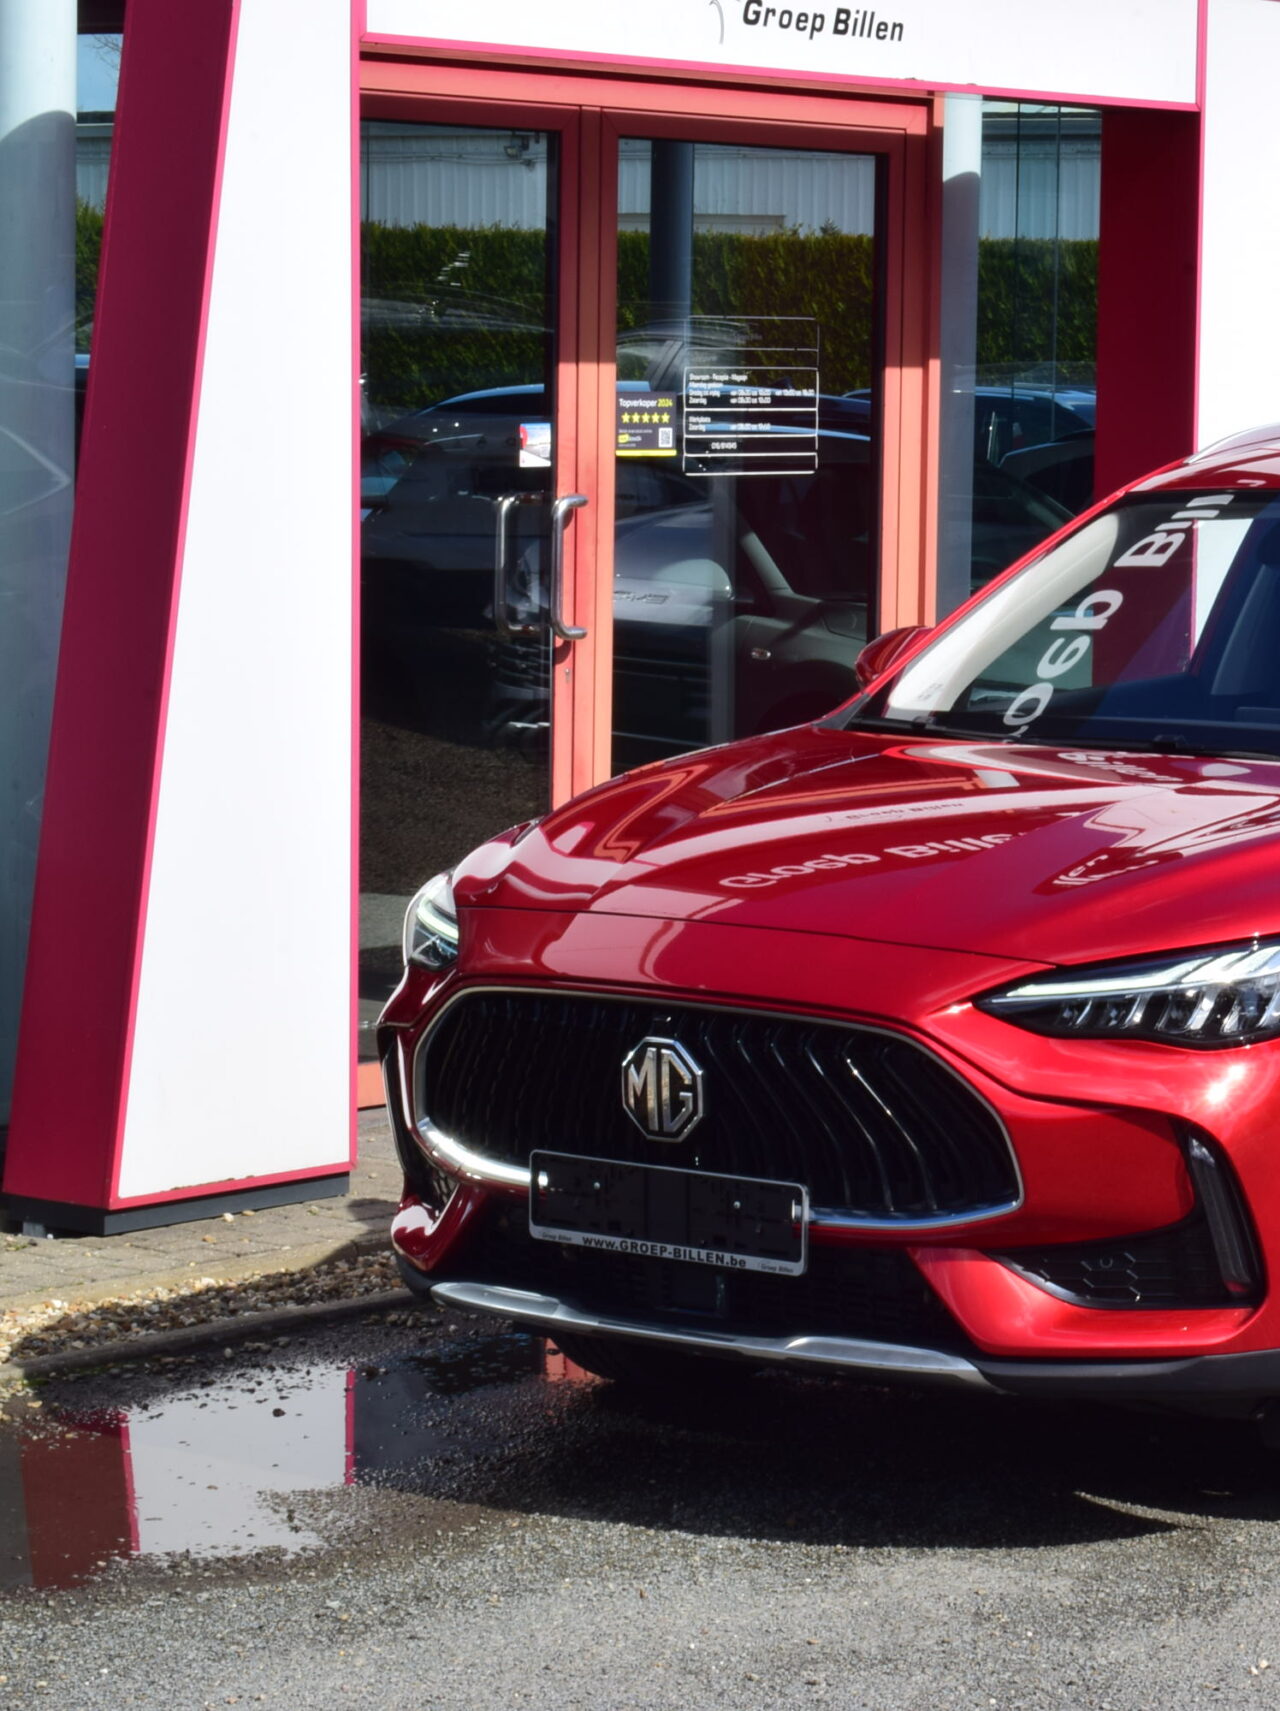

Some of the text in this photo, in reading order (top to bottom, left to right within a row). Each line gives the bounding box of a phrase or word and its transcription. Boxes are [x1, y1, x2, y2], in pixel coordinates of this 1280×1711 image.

[742, 0, 905, 42] Groep Billen
[628, 1047, 693, 1132] MG
[582, 1236, 746, 1268] www.GROEP-BILLEN.be
